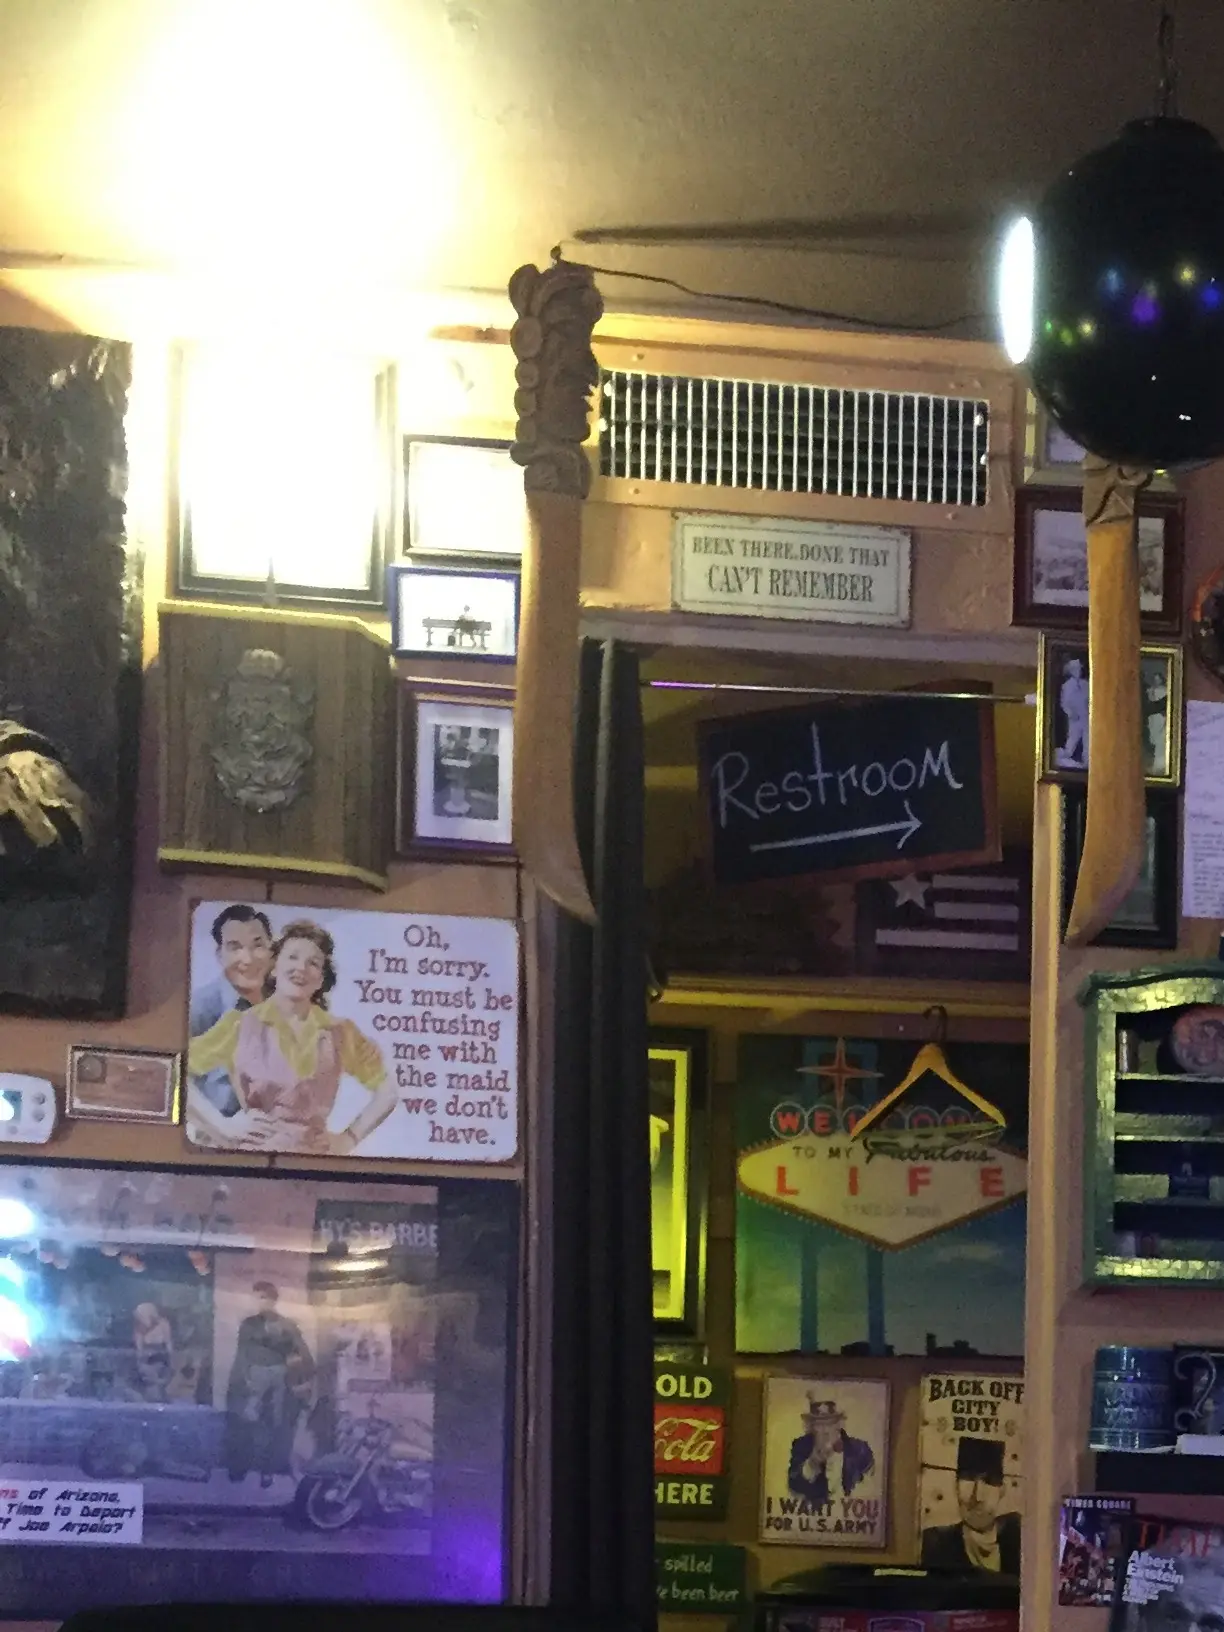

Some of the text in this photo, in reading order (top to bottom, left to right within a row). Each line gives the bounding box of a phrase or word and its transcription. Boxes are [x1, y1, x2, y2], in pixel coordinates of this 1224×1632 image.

[693, 536, 735, 556] BEEN
[849, 547, 889, 567] THAT
[708, 564, 874, 602] CAN'T REMEMBER
[403, 923, 450, 951] Oh,
[368, 949, 490, 982] I'm sorry.
[353, 980, 513, 1011] You must be
[372, 1011, 501, 1042] confusing
[393, 1041, 498, 1064] me with
[395, 1064, 511, 1092] the maid
[402, 1094, 508, 1120] we don't
[428, 1120, 496, 1146] have.
[655, 1373, 713, 1399] OLD
[929, 1379, 1024, 1405] BACK OFF
[951, 1399, 1000, 1416] CITY
[28, 1487, 48, 1501] of
[54, 1503, 72, 1517] to
[80, 1505, 136, 1521] Deport
[766, 1496, 773, 1514] I
[841, 1498, 880, 1519] YOU
[765, 1518, 793, 1532] FOR
